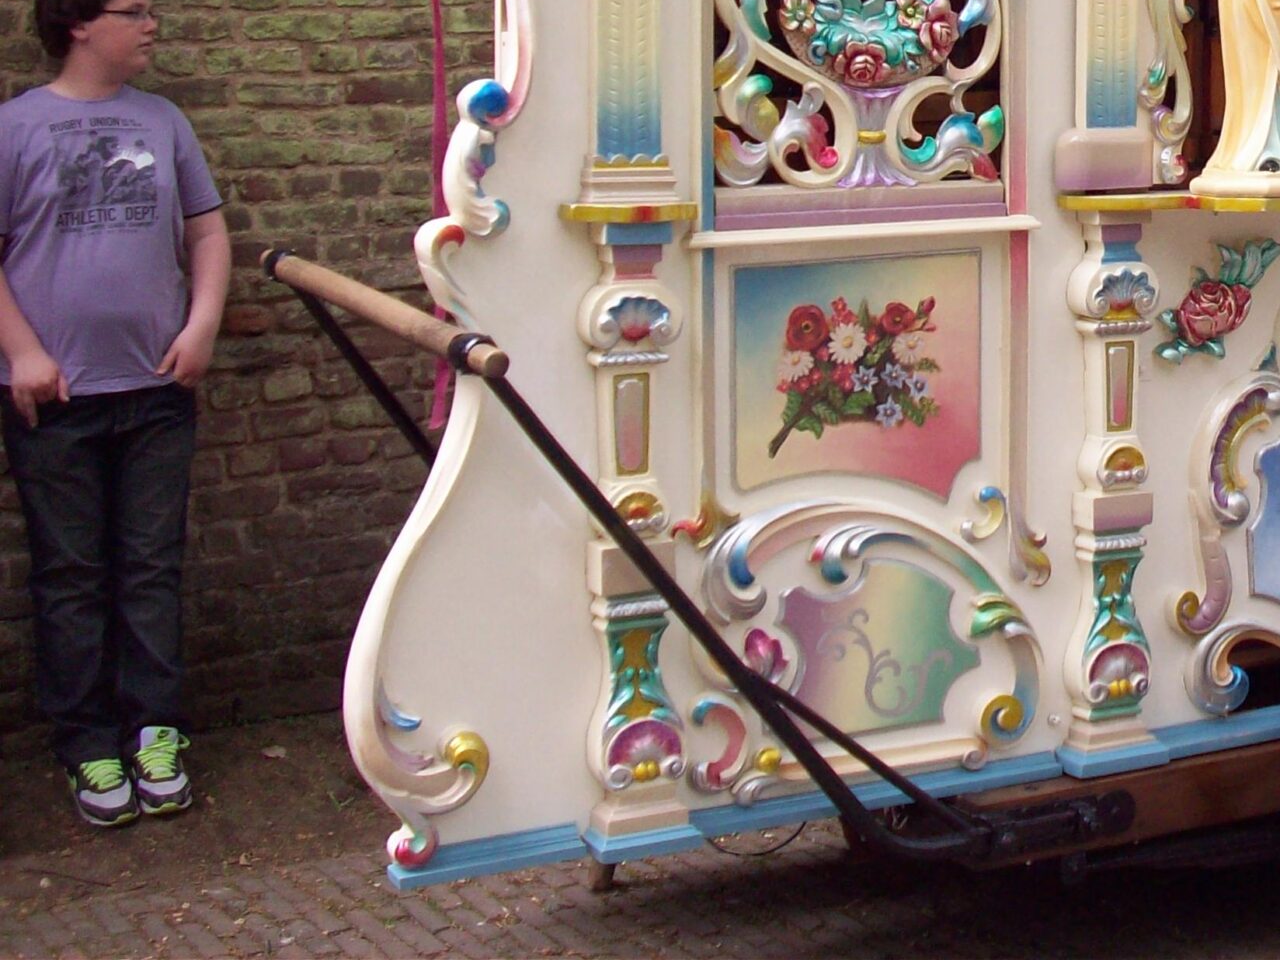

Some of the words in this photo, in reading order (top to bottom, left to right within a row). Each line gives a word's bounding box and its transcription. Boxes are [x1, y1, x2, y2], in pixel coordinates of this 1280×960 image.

[48, 119, 83, 133] RUGBY
[89, 116, 120, 127] UNION
[55, 207, 117, 227] ATHLETIC
[125, 205, 159, 221] DEPT.
